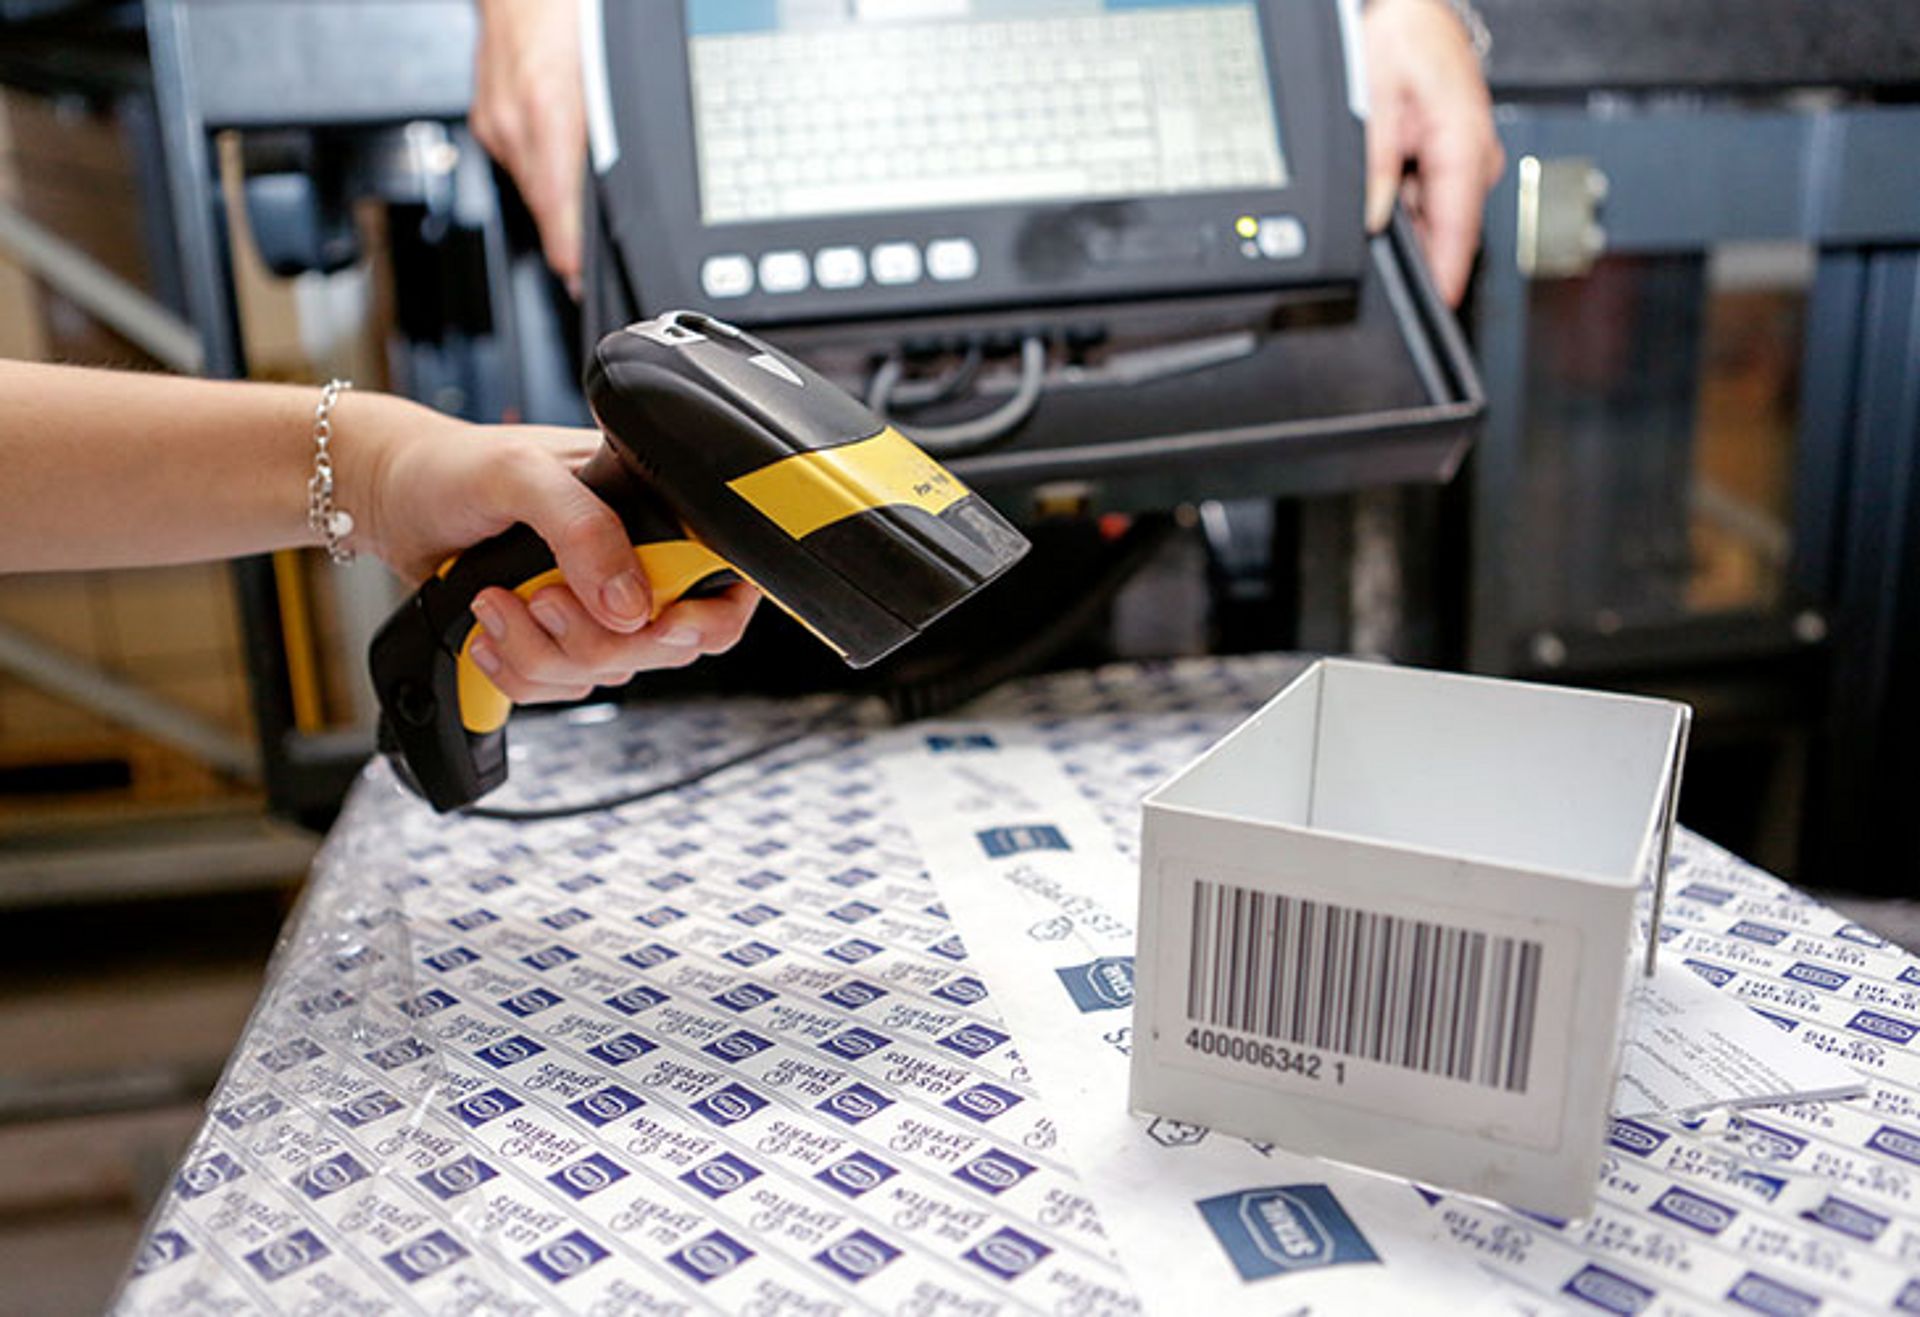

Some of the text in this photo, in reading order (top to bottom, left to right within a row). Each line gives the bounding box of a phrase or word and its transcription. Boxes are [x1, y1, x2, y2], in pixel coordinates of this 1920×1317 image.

[1185, 1028, 1345, 1085] 400006342 1
[896, 1118, 979, 1152] EXPERTS
[922, 1144, 961, 1163] LES
[1259, 1199, 1317, 1256] STAHL
